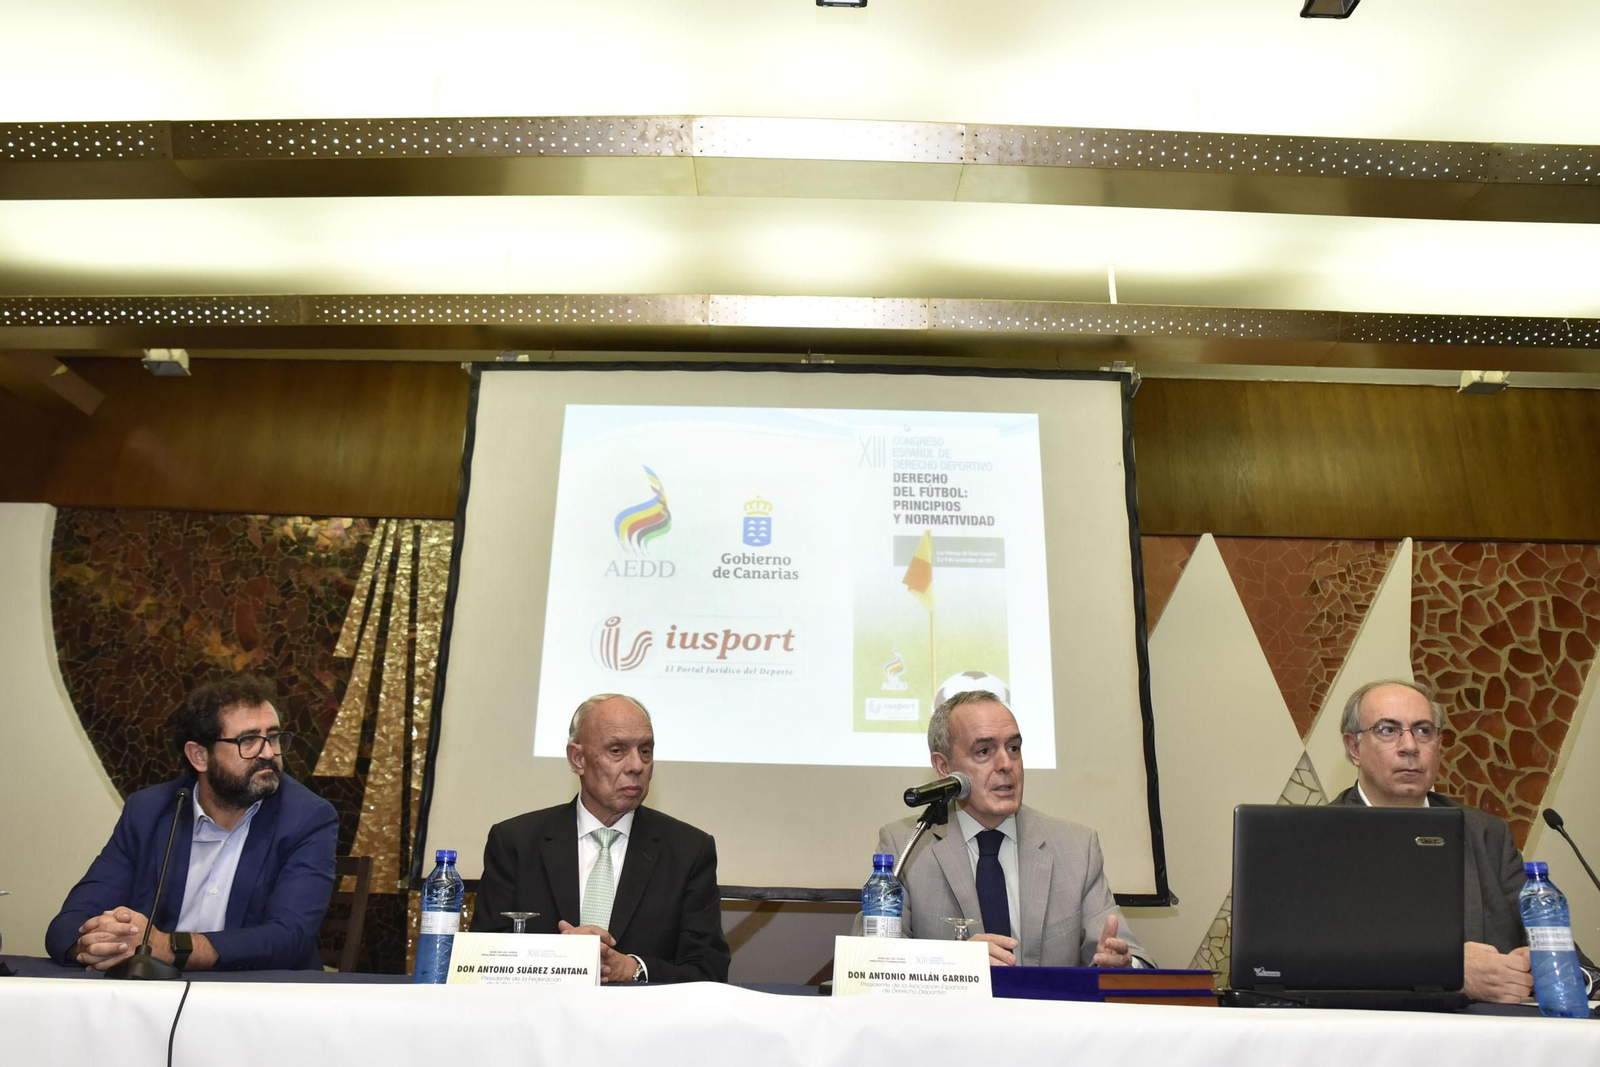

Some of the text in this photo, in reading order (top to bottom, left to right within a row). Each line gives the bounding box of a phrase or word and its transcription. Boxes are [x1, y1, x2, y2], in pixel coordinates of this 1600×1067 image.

[892, 436, 944, 446] CONGRESO
[858, 435, 886, 469] XIII
[892, 448, 952, 459] ESPAÑOL DE
[892, 460, 993, 472] DERECHO DEPORTIVO
[893, 472, 948, 484] DERECHO
[893, 485, 968, 498] DEL FÚTBOL:
[893, 500, 961, 512] PRINCIPIOS
[893, 514, 995, 526] Y NORMATIVIDAD
[721, 552, 792, 566] Gobierno
[604, 560, 676, 578] AEDD
[712, 566, 799, 580] de Canarias
[666, 624, 795, 660] iusport
[676, 665, 704, 674] Portal
[706, 666, 741, 675] Jurídico
[759, 668, 794, 677] Deporte
[456, 964, 588, 975] DON ANTONIO SUÁREZ SANTANA
[848, 971, 980, 983] DON ANTONIO MILLÁN GARRIDO
